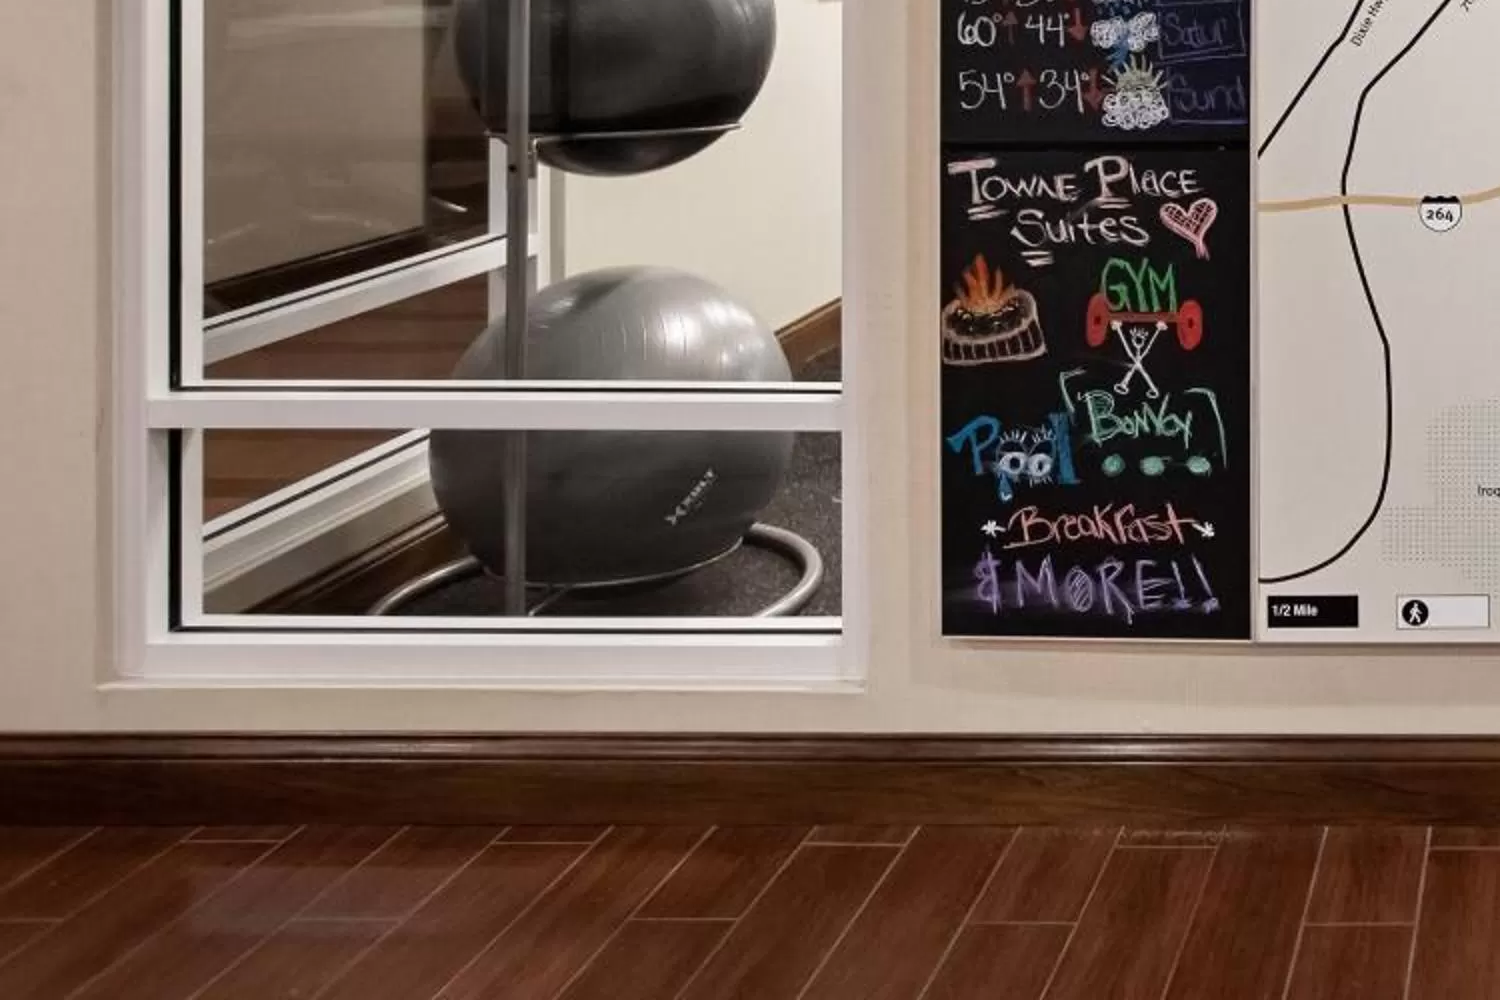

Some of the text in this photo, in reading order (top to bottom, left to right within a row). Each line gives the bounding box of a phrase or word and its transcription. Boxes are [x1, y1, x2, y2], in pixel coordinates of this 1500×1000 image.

[1350, 13, 1374, 48] Dixie
[1426, 207, 1454, 222] 264
[1102, 257, 1180, 313] GYM
[1272, 604, 1320, 618] 1/2 Mile
